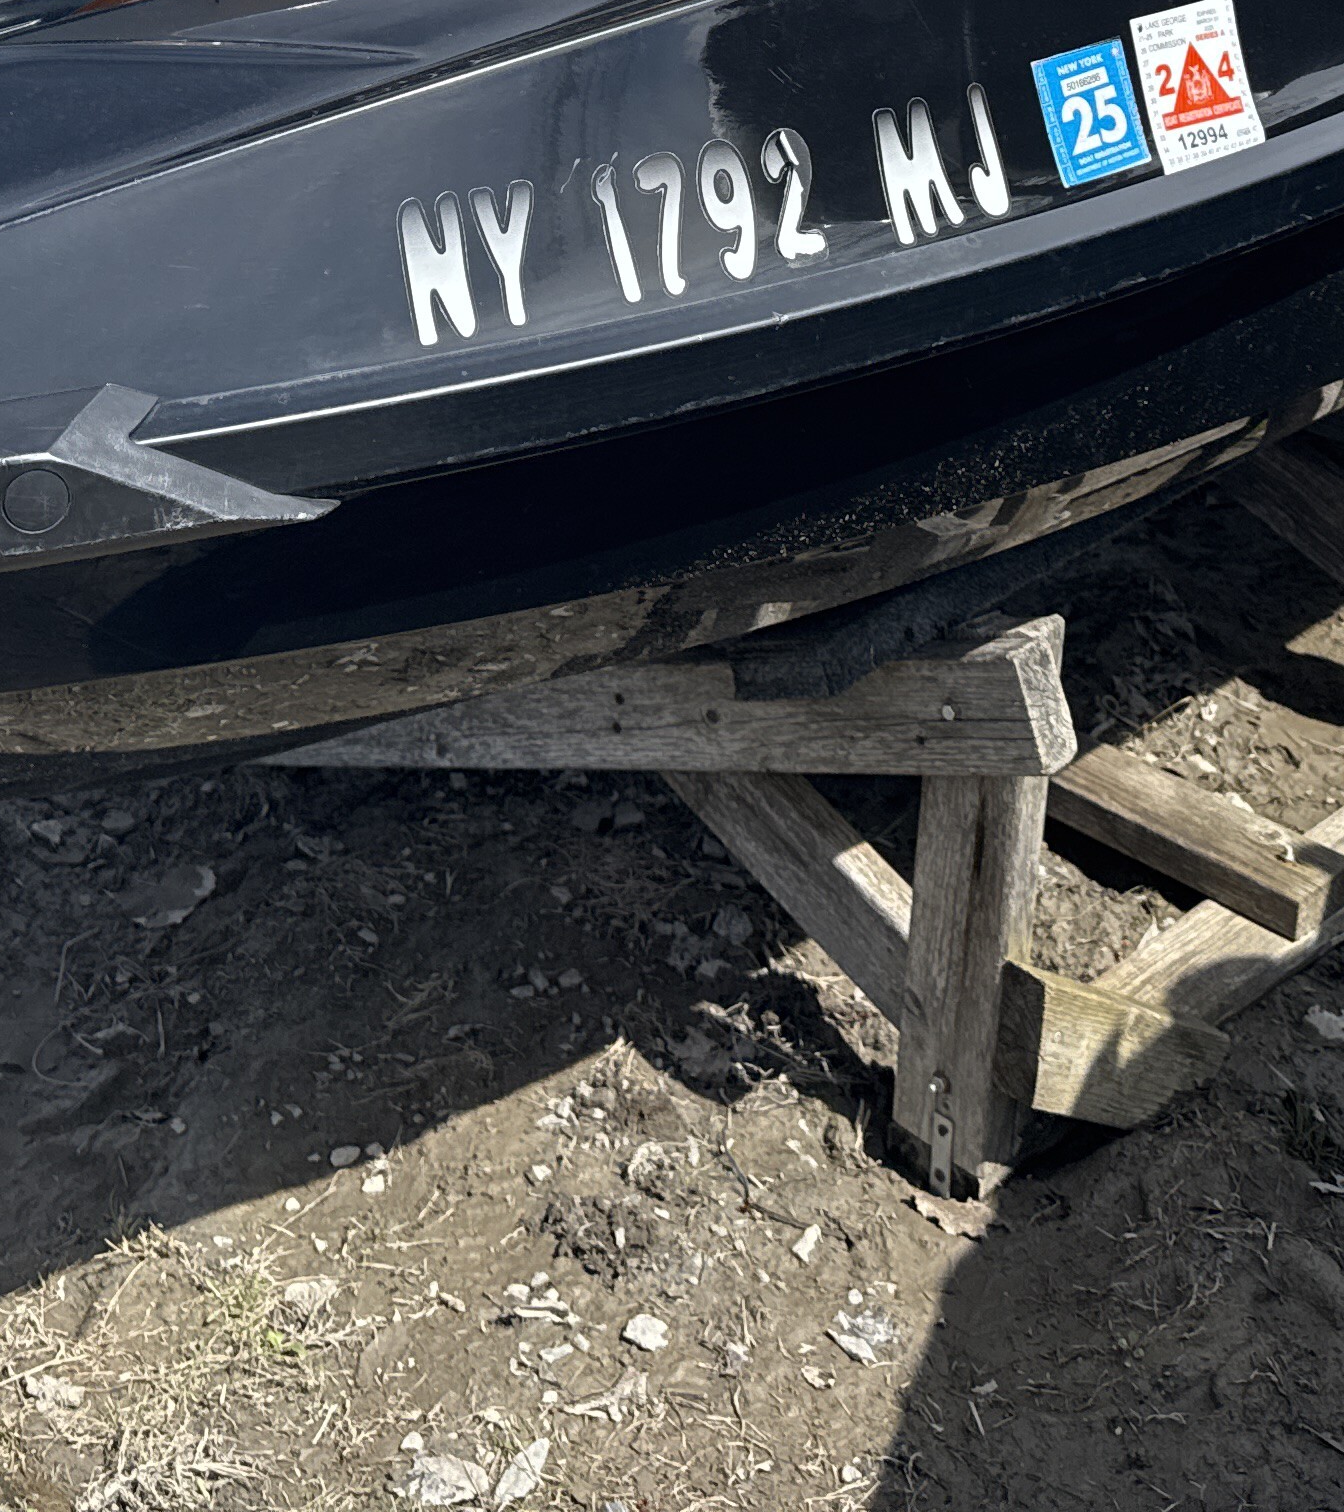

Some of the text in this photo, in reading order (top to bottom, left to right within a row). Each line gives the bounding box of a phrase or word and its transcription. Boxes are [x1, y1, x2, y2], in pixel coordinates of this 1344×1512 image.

[1161, 14, 1187, 27] GEORGE
[1148, 38, 1187, 52] COMMISSION
[1158, 29, 1174, 38] PARK
[1057, 52, 1104, 76] NEW YORK
[1155, 50, 1235, 97] 2 4
[1061, 84, 1128, 157] 25
[1178, 123, 1228, 150] 12994
[396, 83, 1011, 349] NY 1792 MJ
